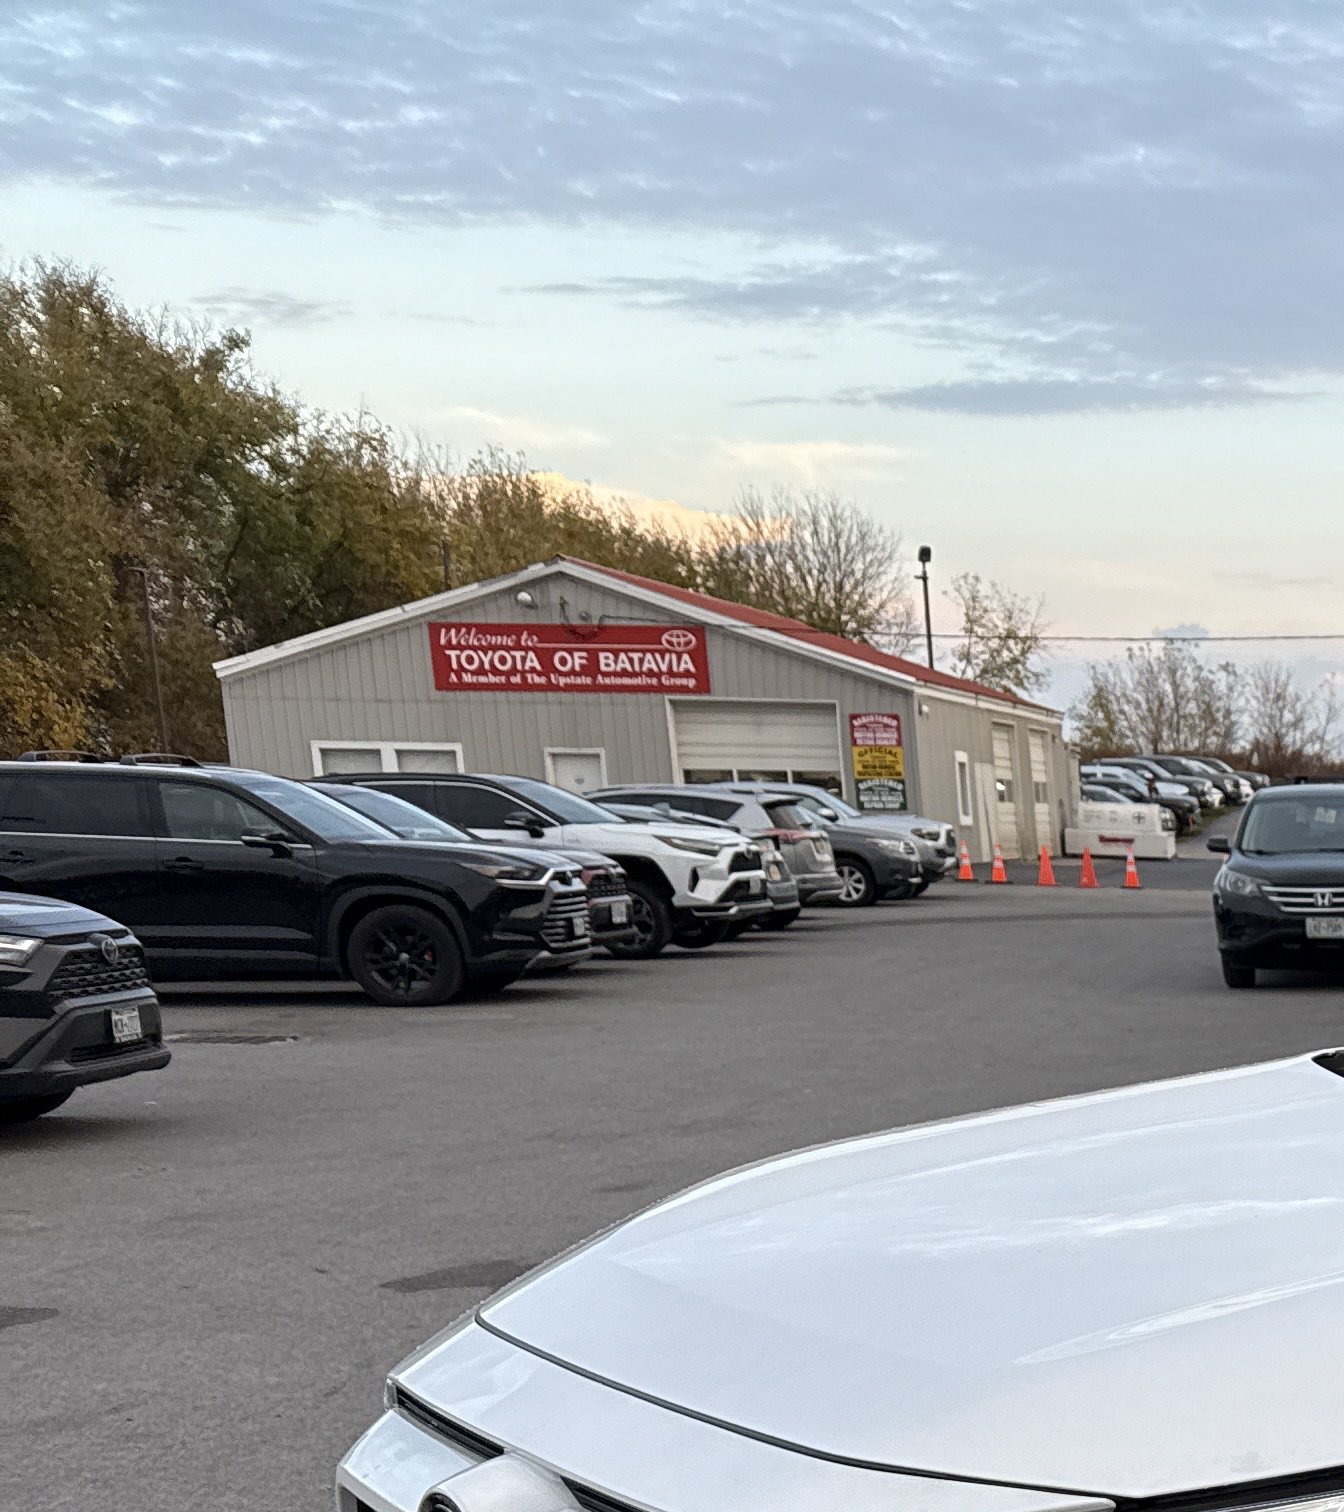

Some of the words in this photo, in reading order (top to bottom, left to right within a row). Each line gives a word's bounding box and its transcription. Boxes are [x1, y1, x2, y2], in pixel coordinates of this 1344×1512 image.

[439, 627, 517, 647] Welcome
[521, 630, 538, 647] to
[444, 650, 542, 672] TOYOTA
[553, 651, 589, 672] OF
[599, 651, 696, 673] BATAVIA
[449, 672, 458, 682] A
[461, 672, 505, 684] Member
[510, 672, 521, 684] of
[524, 673, 547, 684] The
[550, 673, 593, 687] Upstate
[596, 674, 658, 686] Automotive
[661, 675, 696, 688] Group
